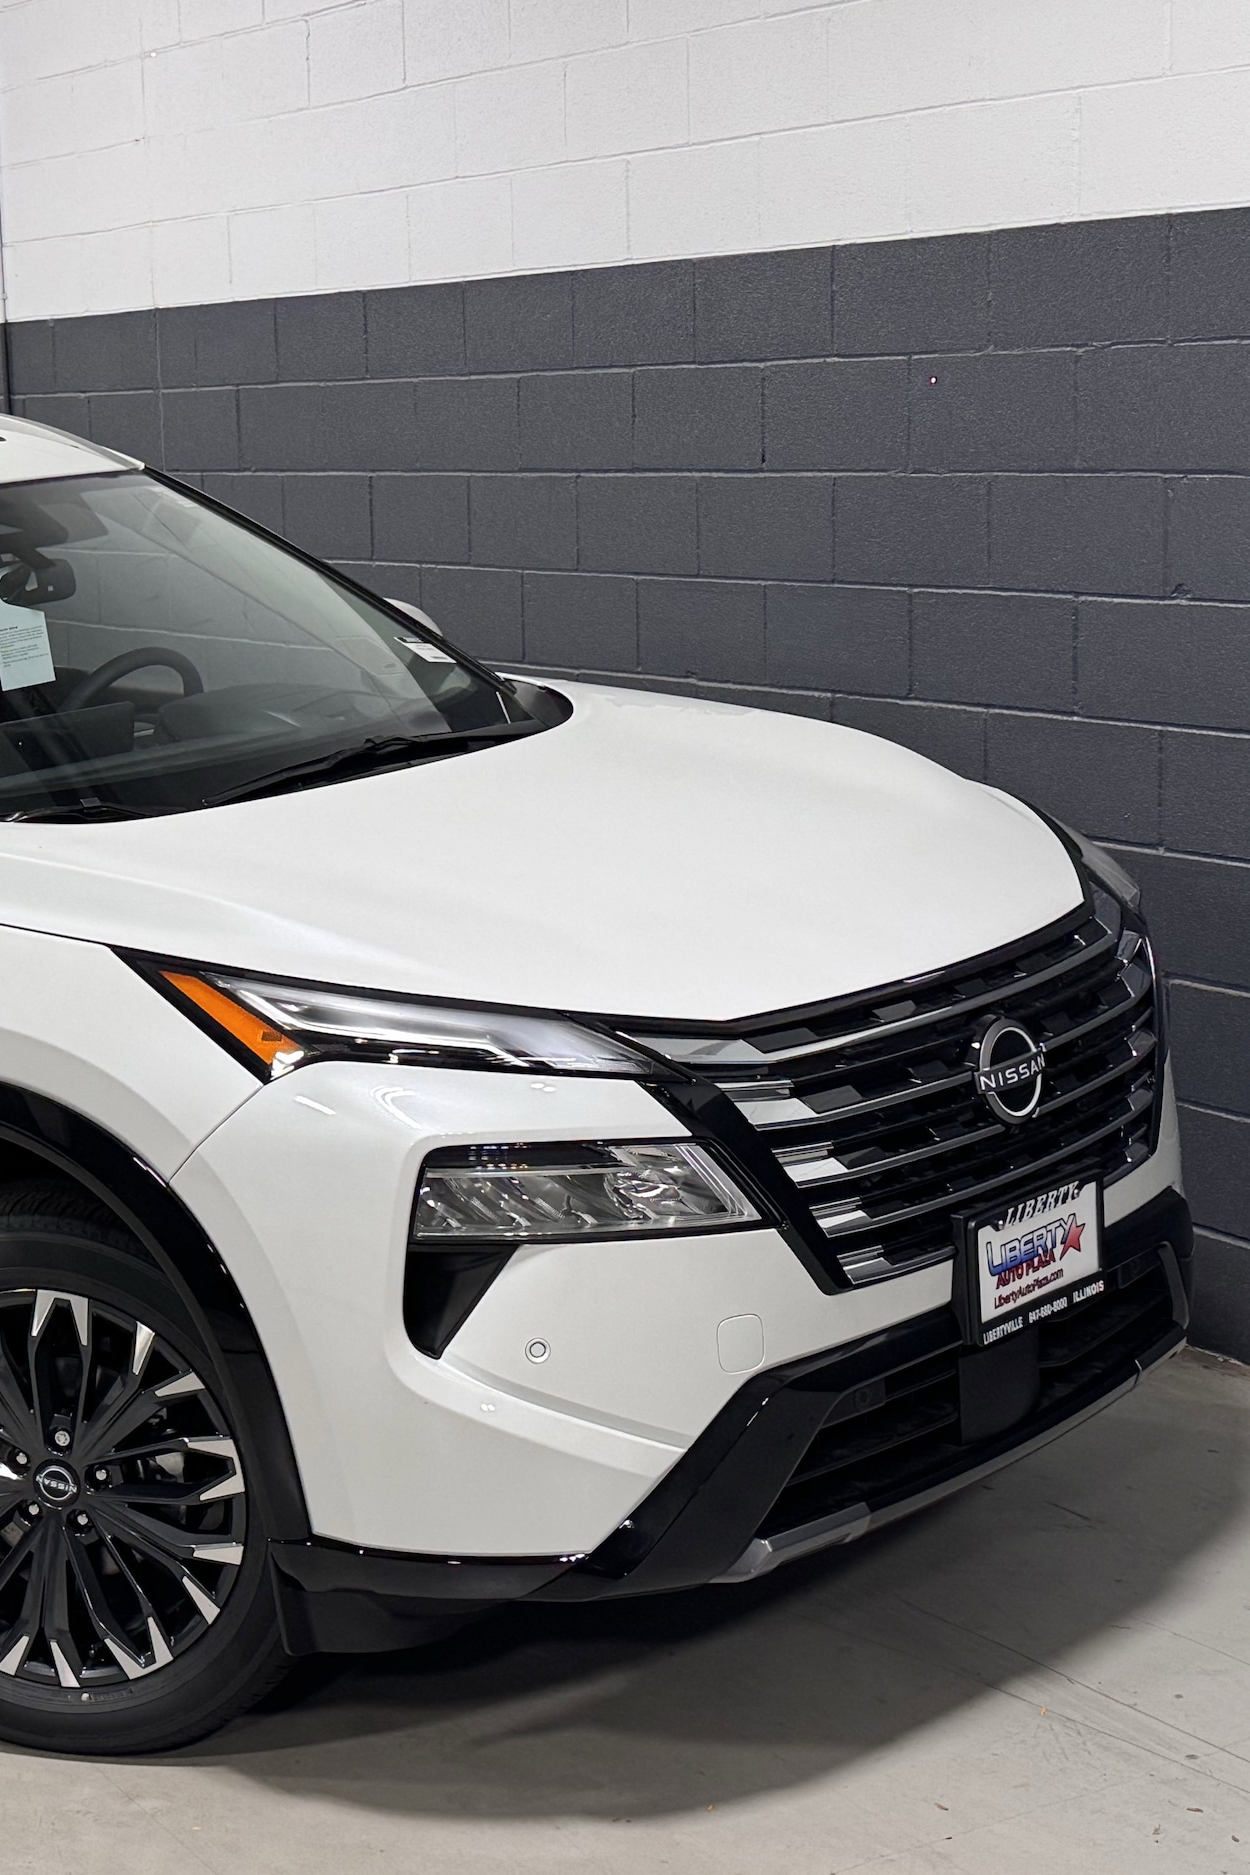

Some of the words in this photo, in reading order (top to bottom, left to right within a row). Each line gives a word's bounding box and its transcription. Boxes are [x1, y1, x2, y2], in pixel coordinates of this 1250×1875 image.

[980, 1053, 1046, 1091] NISSAN
[1005, 1181, 1080, 1227] LIBERTY
[986, 1212, 1078, 1277] LIBERTY
[995, 1262, 1024, 1290] AUTO
[1026, 1248, 1057, 1277] PLAZA
[983, 1316, 1024, 1346] LIBERTYVILLE
[1072, 1279, 1105, 1304] ILLINOIS
[35, 1474, 78, 1494] NISSAN
